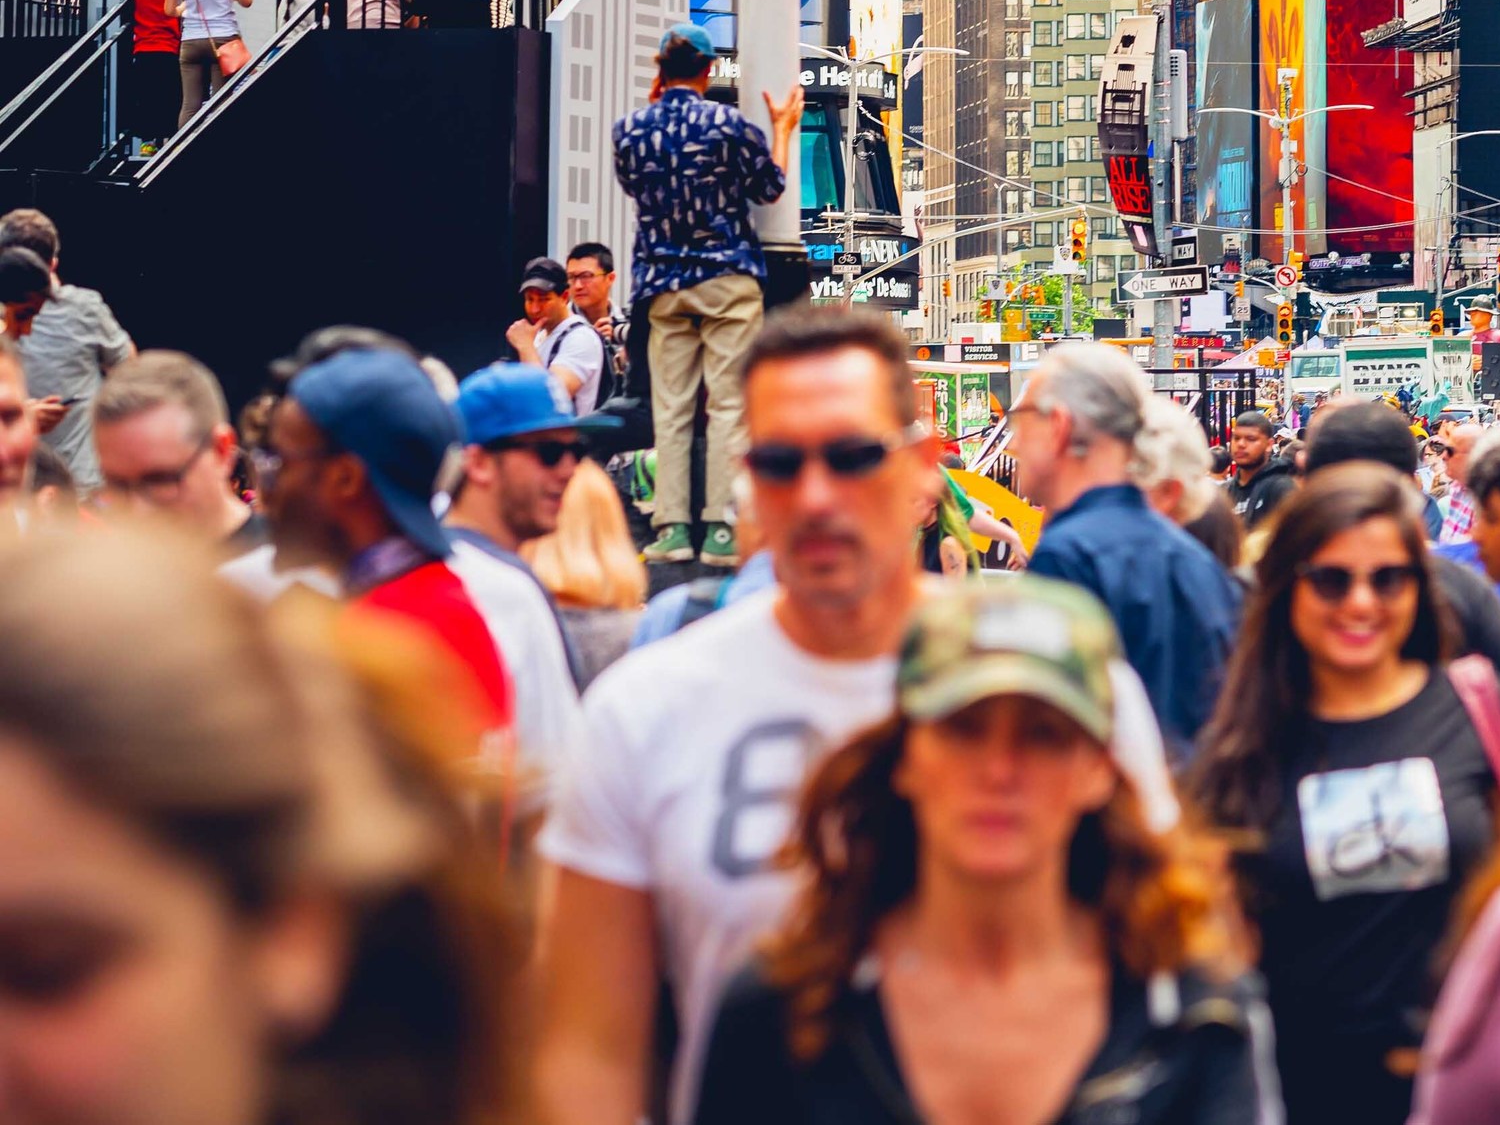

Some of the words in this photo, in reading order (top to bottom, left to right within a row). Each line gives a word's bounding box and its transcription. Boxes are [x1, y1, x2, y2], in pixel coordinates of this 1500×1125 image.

[1109, 155, 1146, 185] ALL
[1109, 183, 1152, 214] RISE
[1177, 244, 1194, 260] WAY
[1131, 278, 1158, 292] ONE
[1168, 276, 1197, 289] WAY
[1236, 306, 1249, 314] 25
[964, 345, 994, 353] VISITOR
[964, 352, 999, 361] SERVICES
